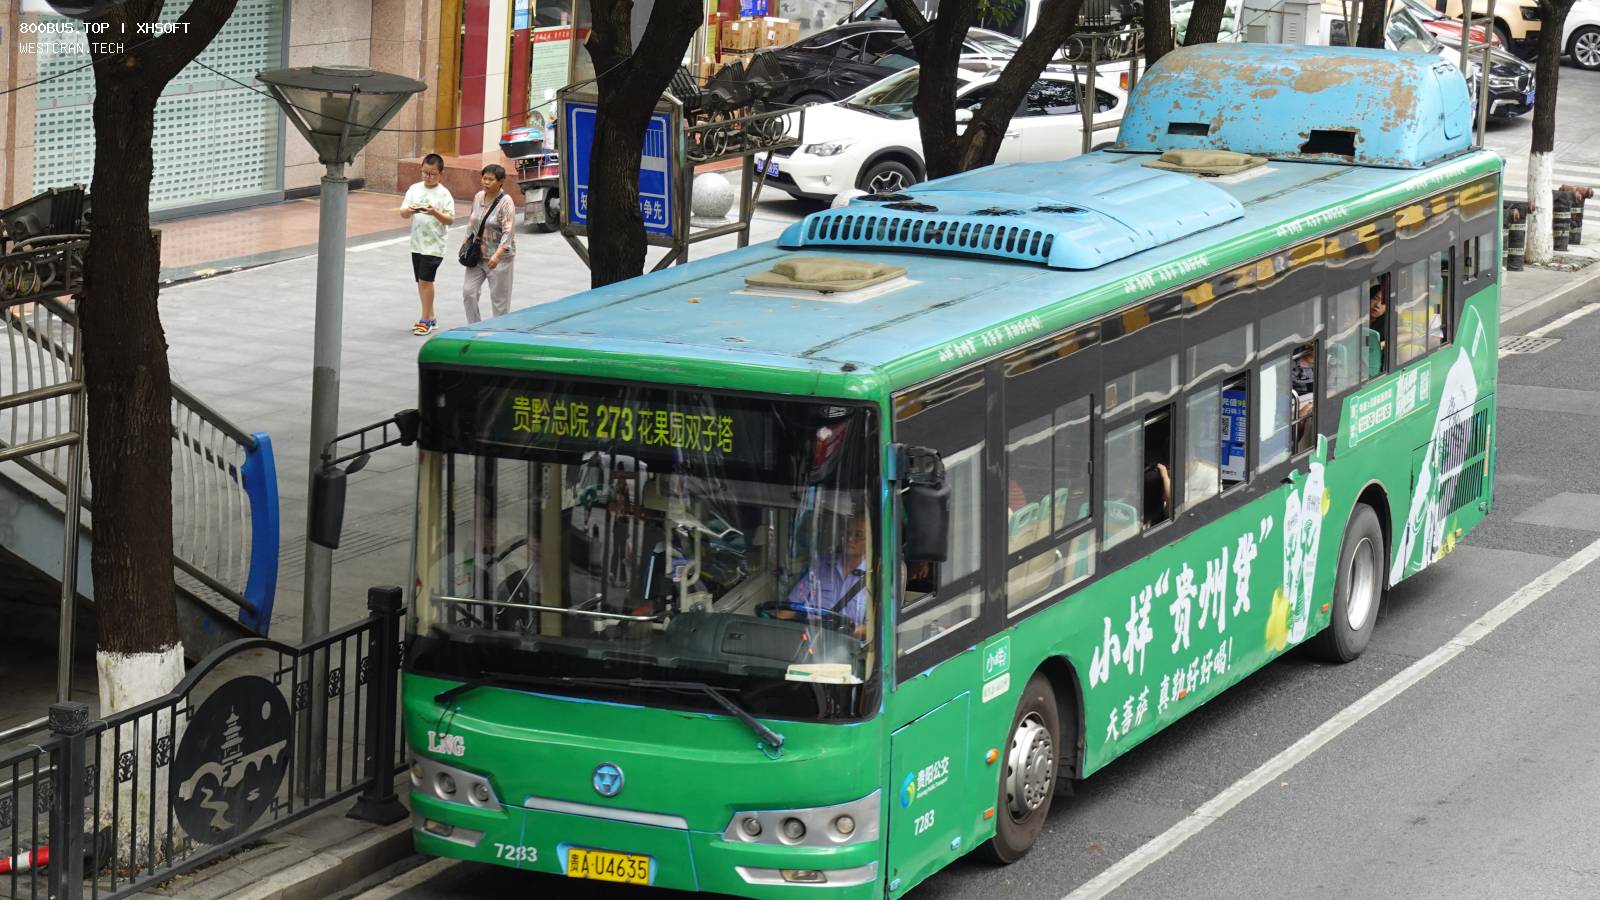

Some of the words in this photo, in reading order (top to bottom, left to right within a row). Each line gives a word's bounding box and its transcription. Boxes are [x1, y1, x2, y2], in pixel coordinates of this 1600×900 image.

[512, 396, 590, 438] 贵黔总院
[596, 404, 634, 442] 273
[638, 410, 734, 453] 花果园双子塔
[428, 730, 466, 757] LNG
[916, 755, 950, 792] 贵阳公交
[914, 808, 935, 836] 7283
[493, 843, 538, 863] 7283
